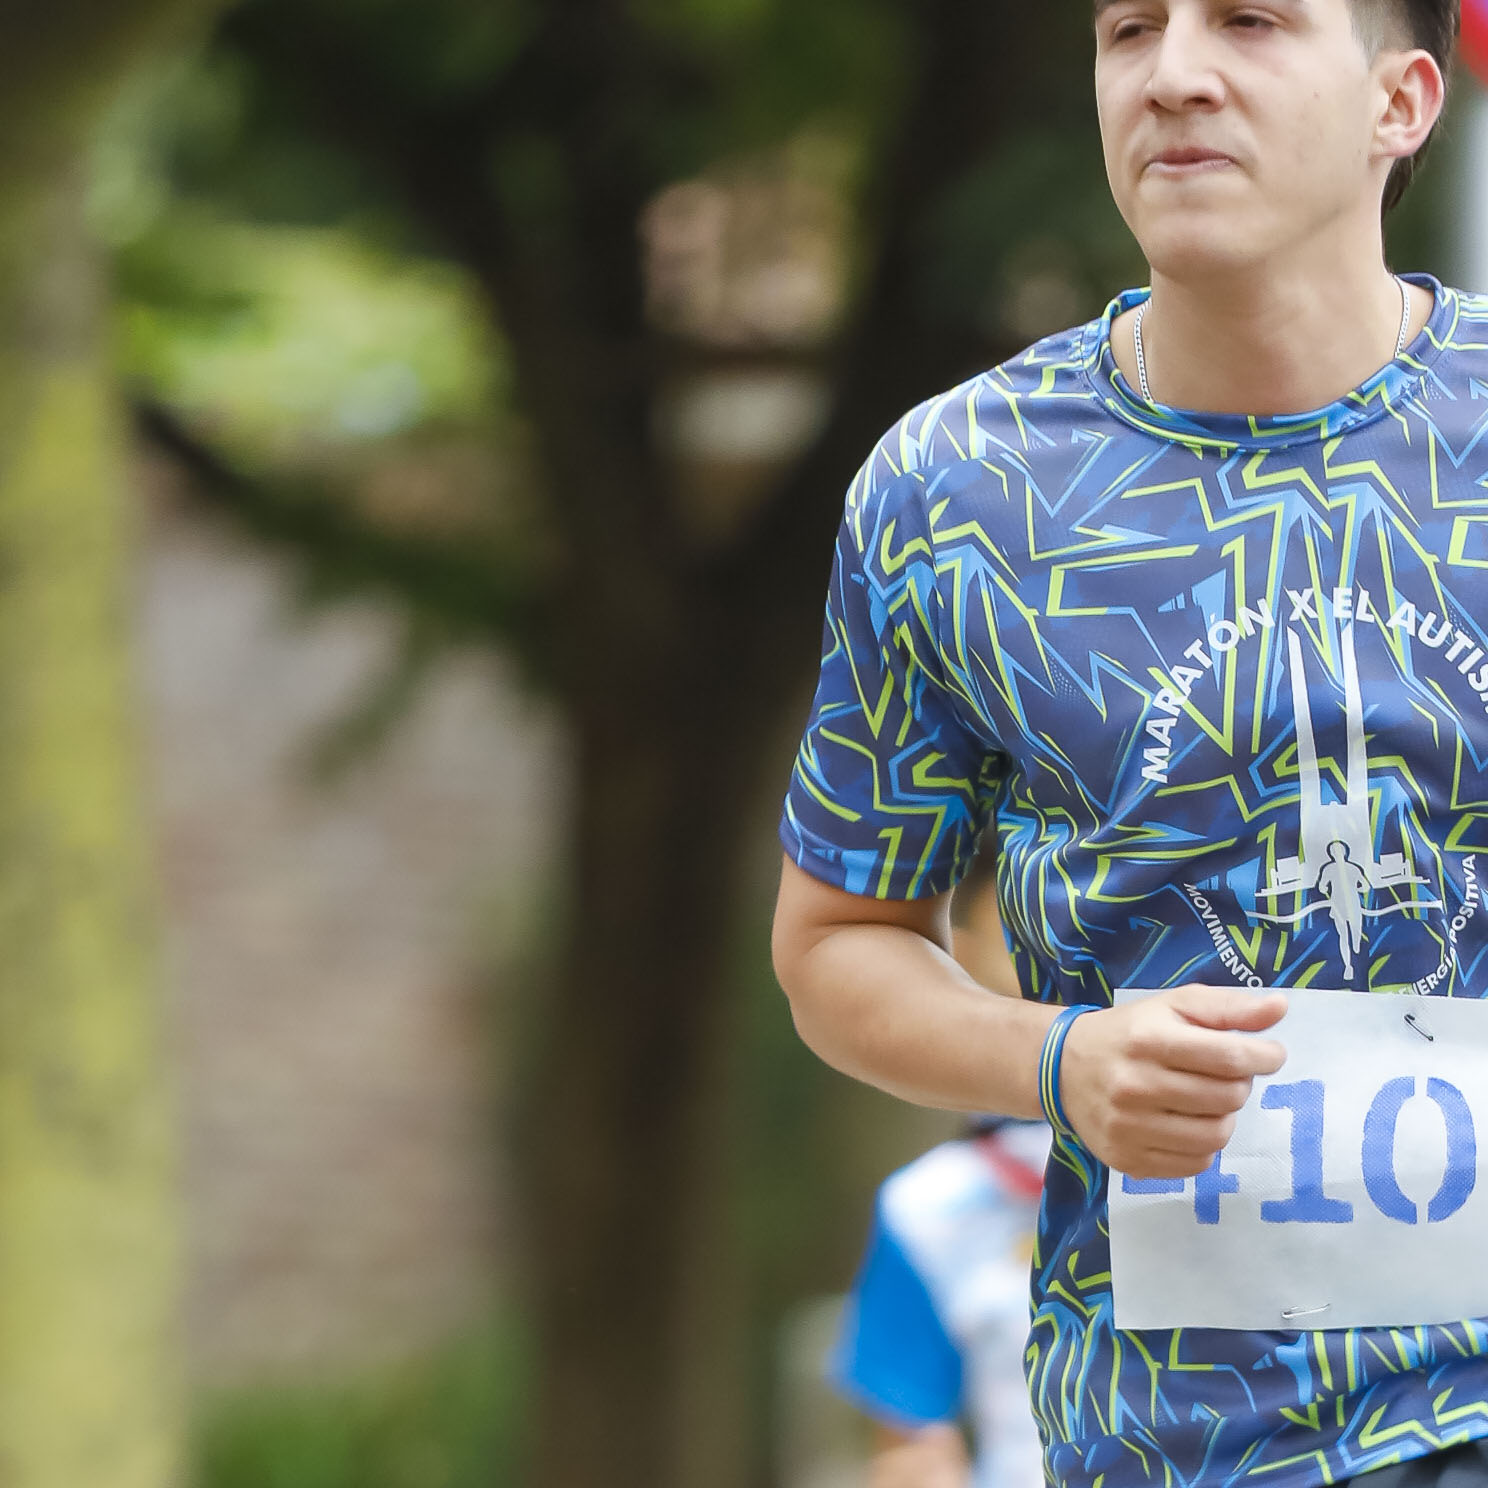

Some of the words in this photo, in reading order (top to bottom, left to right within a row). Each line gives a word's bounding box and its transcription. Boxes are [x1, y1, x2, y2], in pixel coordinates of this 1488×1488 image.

[1141, 598, 1276, 784] MARATÓN
[1286, 588, 1319, 622] X
[1333, 587, 1376, 624] EL
[1183, 883, 1264, 989] MOVIMIENTO
[1448, 854, 1480, 944] POSITIVA
